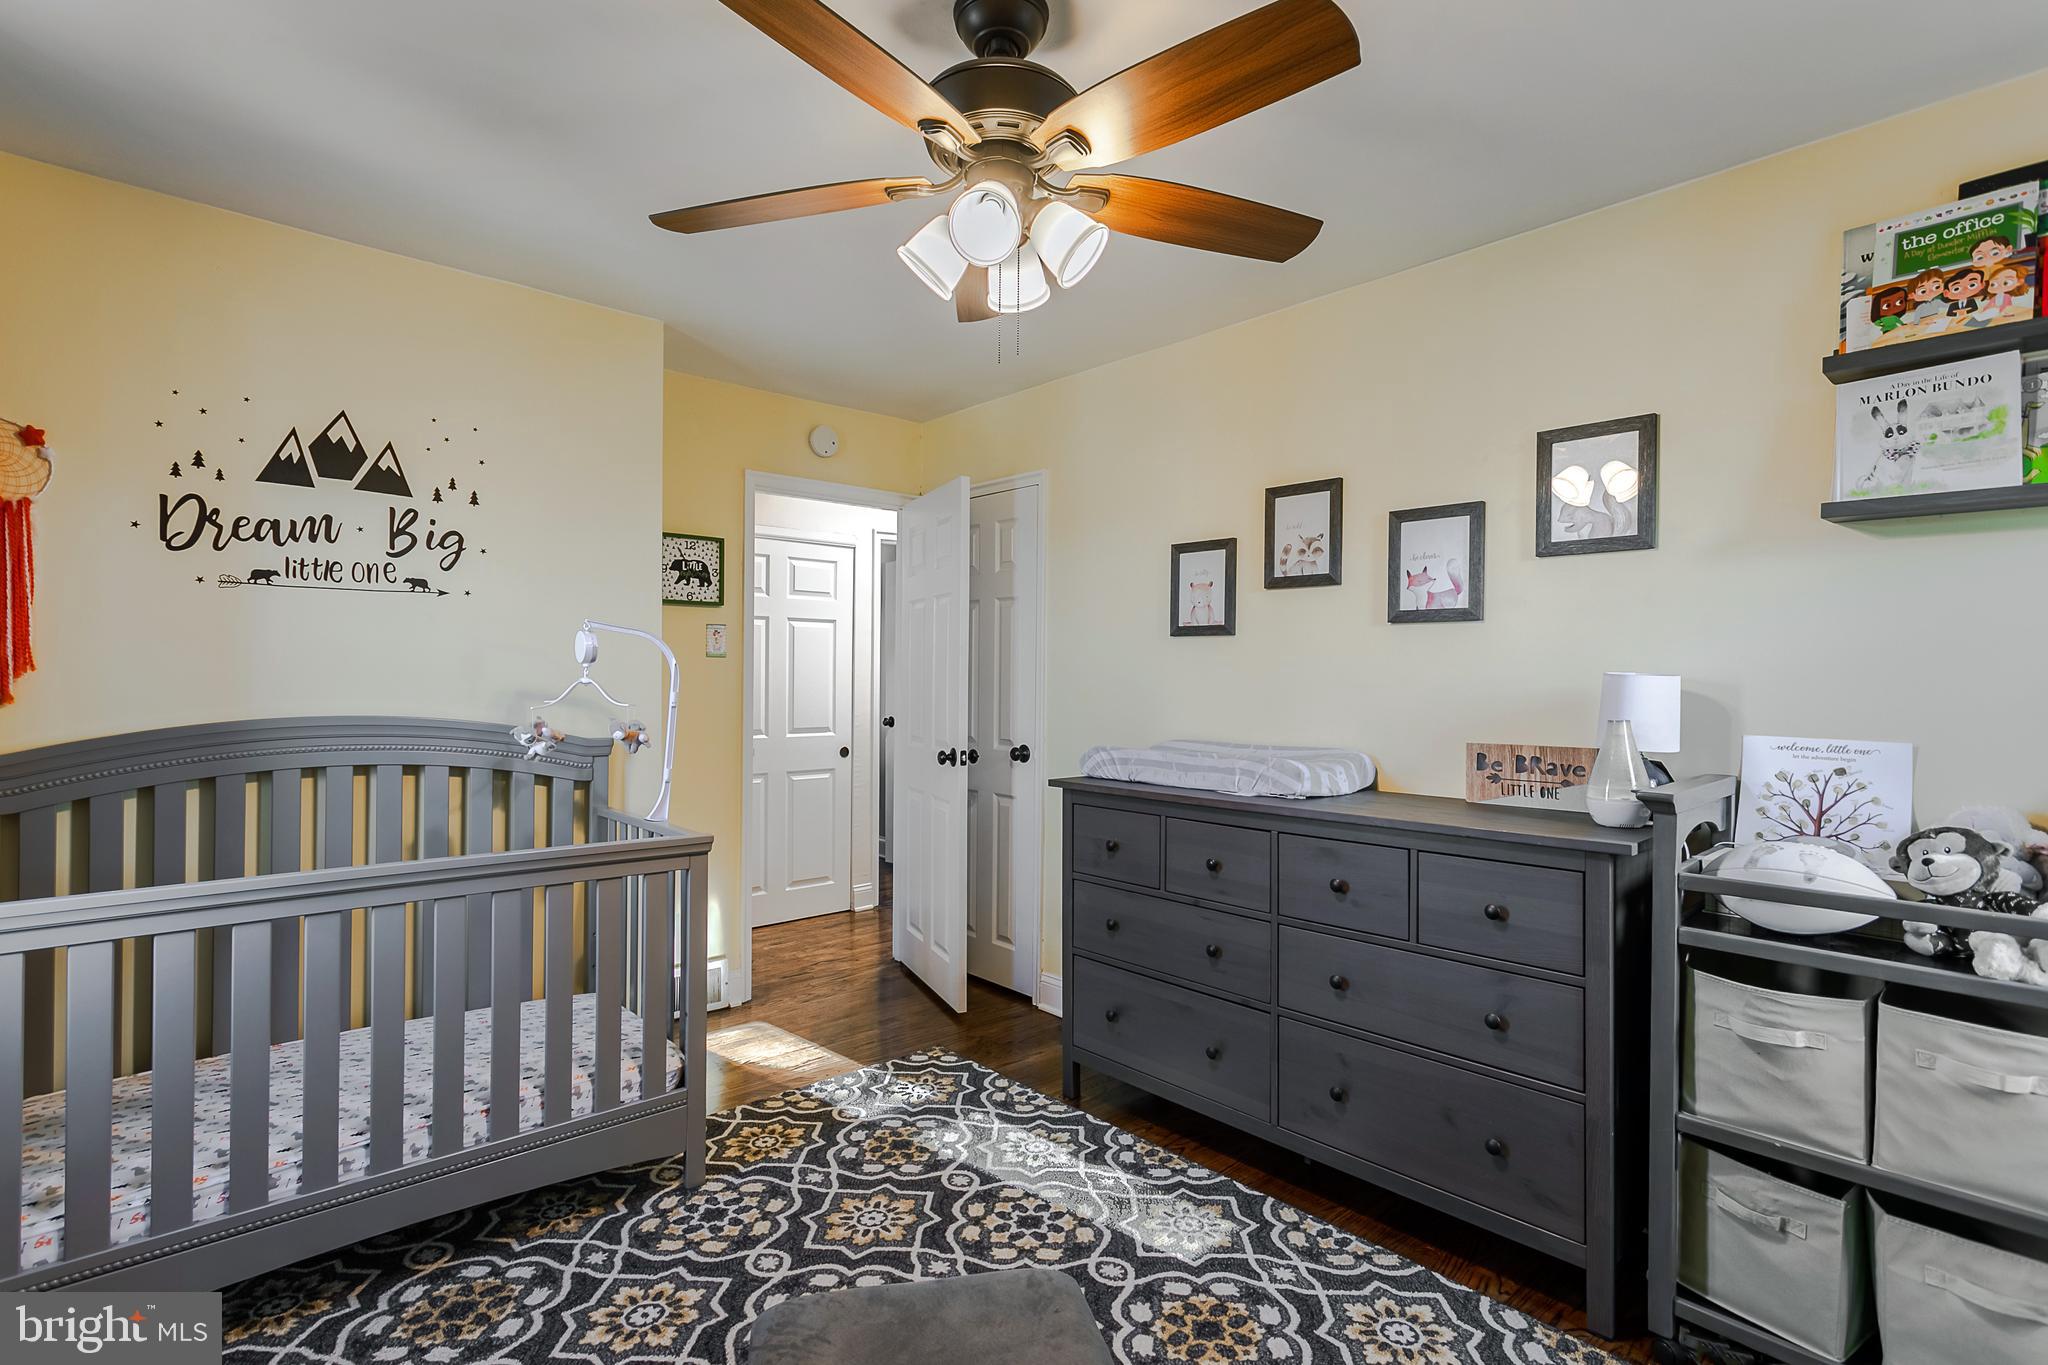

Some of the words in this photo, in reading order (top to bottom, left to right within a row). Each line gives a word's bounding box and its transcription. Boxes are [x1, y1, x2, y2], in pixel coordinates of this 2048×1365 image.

[1901, 232, 1937, 251] the
[1942, 212, 2005, 240] office
[1904, 250, 1910, 258] A
[1912, 249, 1925, 258] Day
[1859, 386, 1928, 406] MARLON
[1932, 373, 1993, 394] BUNDO
[159, 492, 343, 552] Dream
[385, 506, 467, 571] Big
[684, 540, 696, 551] 12
[284, 556, 344, 583] little
[352, 560, 397, 584] one
[712, 568, 718, 578] 3
[686, 592, 694, 601] 6
[1825, 743, 1852, 756] little
[1854, 748, 1879, 756] one
[1476, 752, 1503, 772] Be
[1501, 782, 1535, 798] LITTLE
[1540, 786, 1560, 800] ONE
